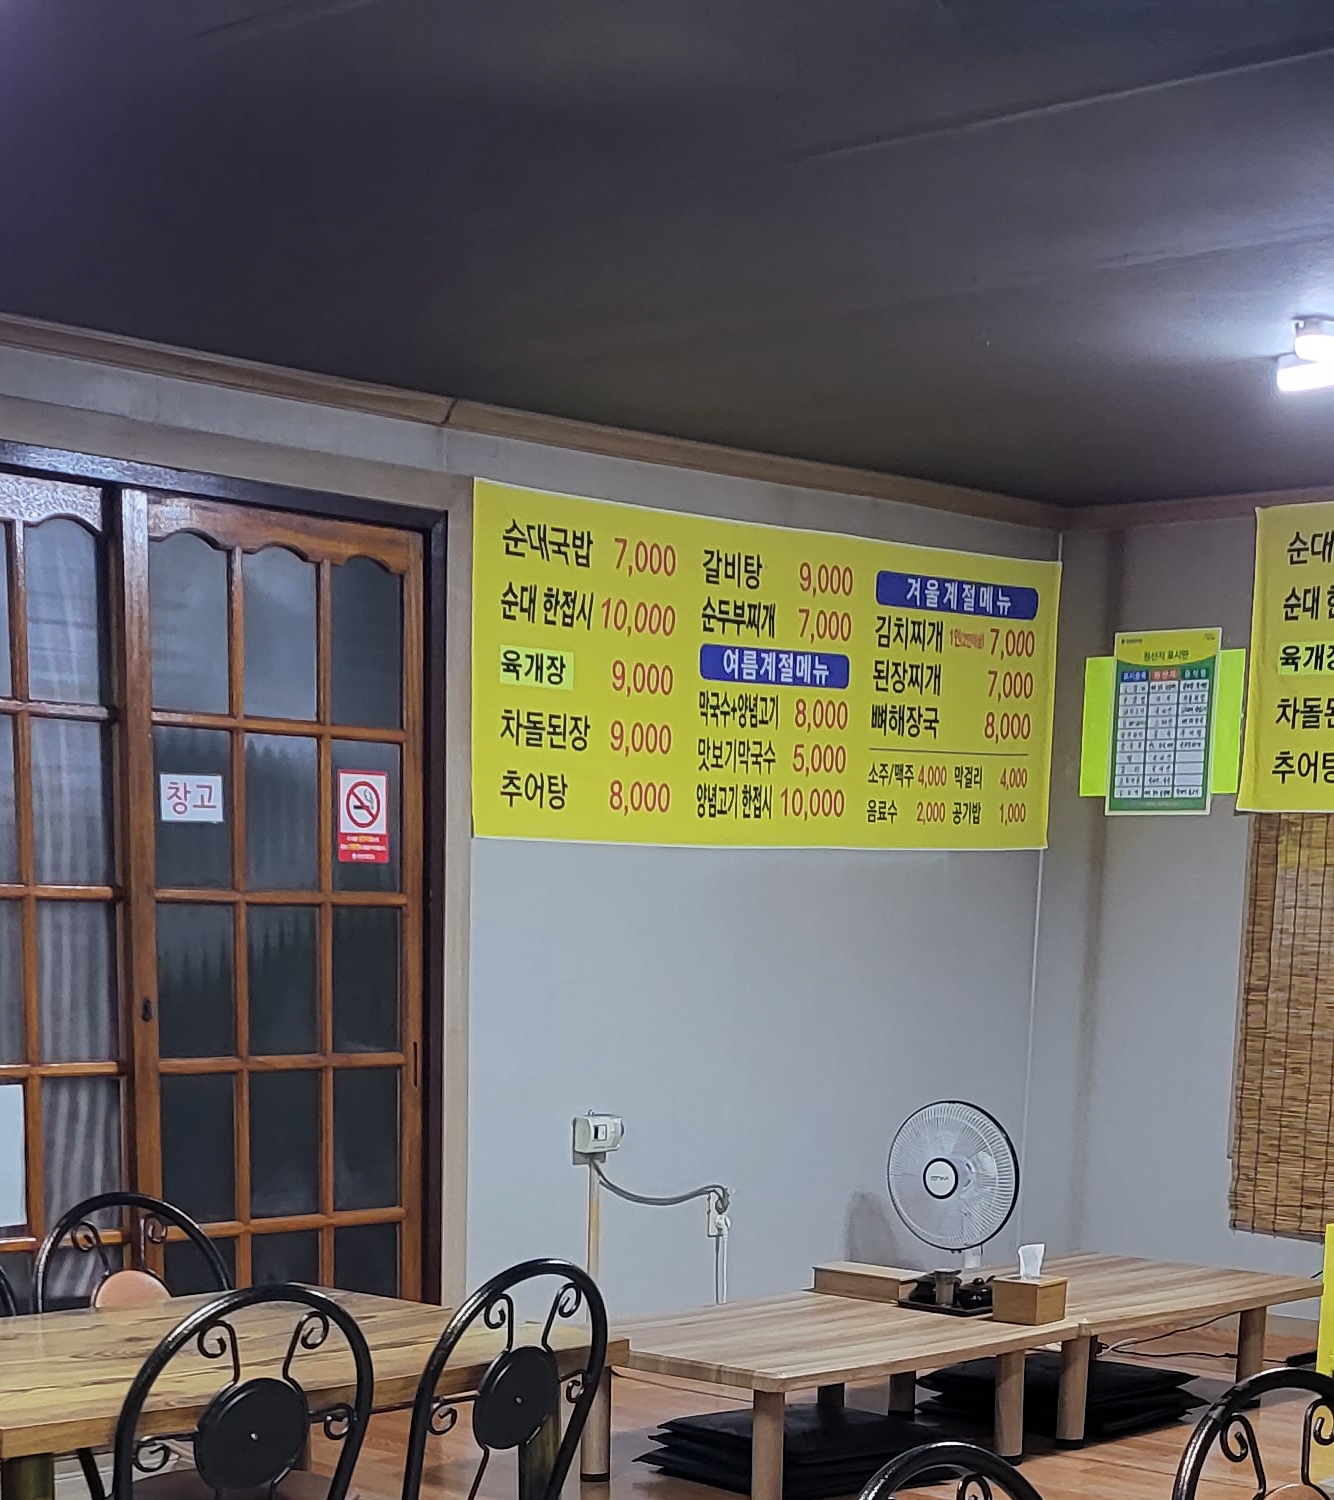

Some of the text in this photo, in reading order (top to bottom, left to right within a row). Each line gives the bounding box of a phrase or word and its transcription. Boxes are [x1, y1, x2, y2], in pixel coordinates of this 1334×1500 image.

[502, 518, 677, 577] 순대국밥 7,000
[702, 549, 854, 596] 갈비탕 9,000
[500, 581, 676, 637] 순대 한접시 10,000
[701, 595, 852, 642] 순두부찌개 7,000
[1282, 585, 1321, 622] 순대
[874, 614, 944, 654] 김치찌개
[990, 627, 1035, 657] 7,000
[500, 649, 674, 697] 육개장 9,000
[872, 659, 1034, 699] 된장찌개 7,000
[500, 708, 672, 756] 차돌된장 9,000
[794, 699, 848, 730] 8,000
[870, 702, 1031, 740] 뼈해장국 8,000
[697, 736, 847, 775] 맛보기막국수 5,000
[867, 762, 947, 788] 소주/맥주 4,000
[499, 769, 671, 815] 추어탕 8,000
[954, 765, 1028, 790] 막걸리 4,000
[166, 781, 217, 815] 창고
[696, 782, 845, 820] 양념고기 한접시 10,000
[866, 799, 946, 824] 음료수 2,000
[952, 801, 1026, 825] 공기밥 1,000
